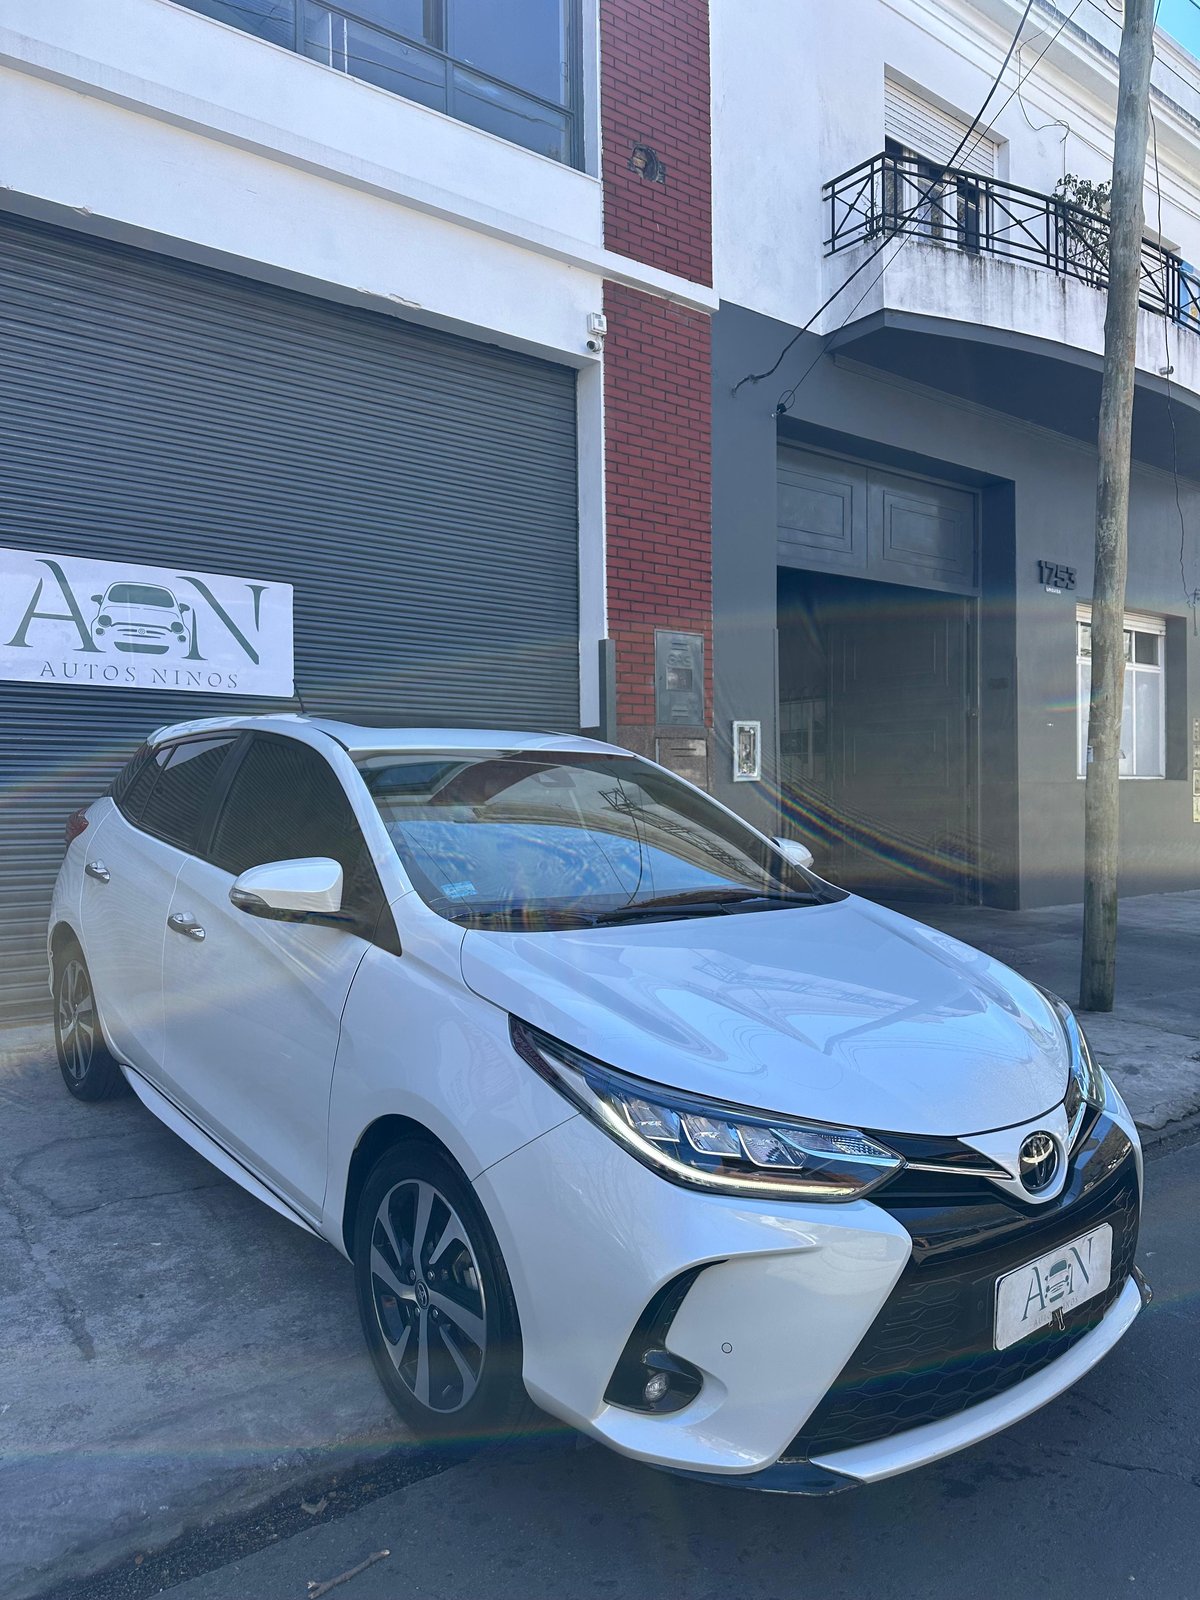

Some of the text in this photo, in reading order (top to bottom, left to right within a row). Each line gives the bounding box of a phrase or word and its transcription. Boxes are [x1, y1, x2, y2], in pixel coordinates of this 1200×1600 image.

[1037, 559, 1077, 590] 1753
[39, 660, 239, 689] AUTOS NINOS
